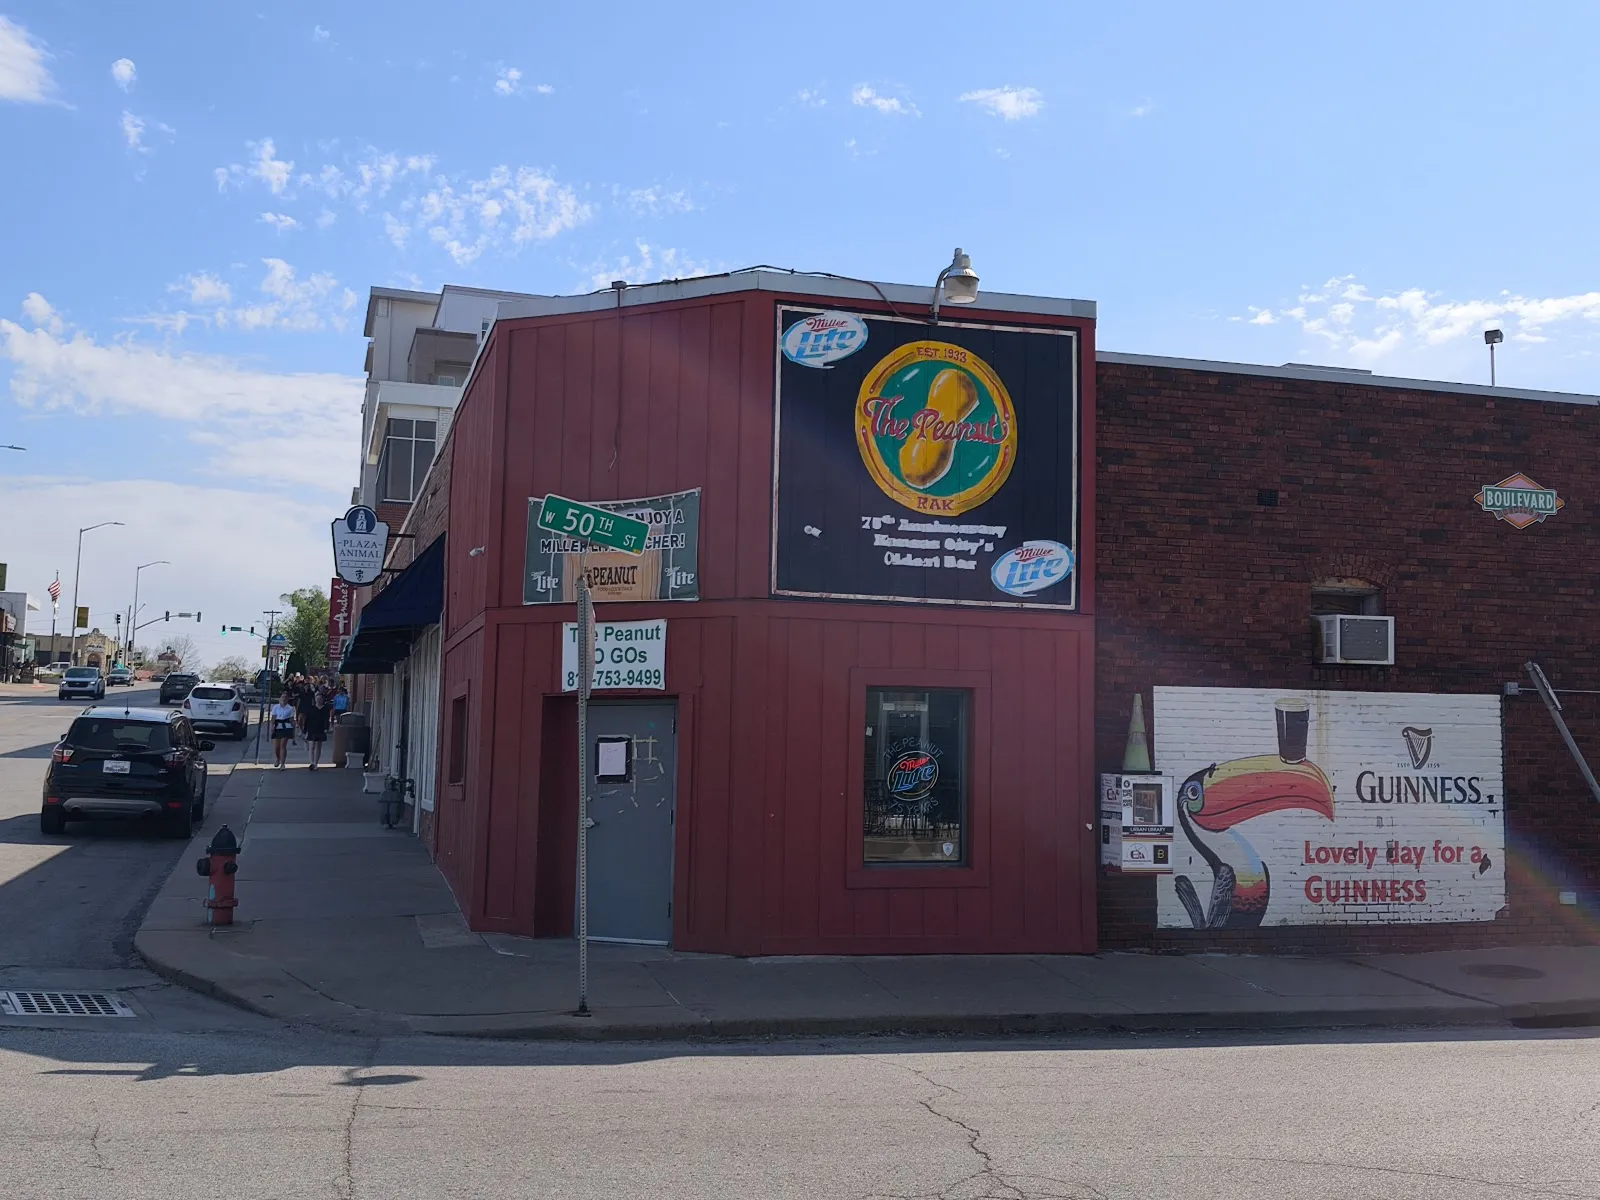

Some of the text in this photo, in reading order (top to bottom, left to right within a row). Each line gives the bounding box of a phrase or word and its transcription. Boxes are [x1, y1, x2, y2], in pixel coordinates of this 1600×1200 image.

[806, 317, 848, 332] Miller
[795, 328, 857, 359] Lite
[944, 348, 967, 363] 1933
[863, 395, 1009, 445] The Peanut
[1486, 490, 1554, 510] BOULEVARD
[626, 509, 684, 525] NJOY A
[545, 511, 556, 524] W
[623, 534, 637, 548] ST
[343, 539, 378, 549] PLAZA
[339, 549, 382, 559] ANIMAL
[1015, 547, 1054, 562] Miller
[593, 565, 638, 586] PEANUT
[669, 571, 695, 589] Lite
[1004, 557, 1064, 589] Lite
[535, 575, 559, 593] Lite
[604, 625, 661, 642] Peanut
[594, 646, 648, 664] O GOs
[567, 669, 661, 687] 8-753-9499
[1355, 770, 1482, 804] GUINNESS
[1304, 839, 1483, 870] Lovely day for a
[1305, 875, 1427, 903] GUINNESS
